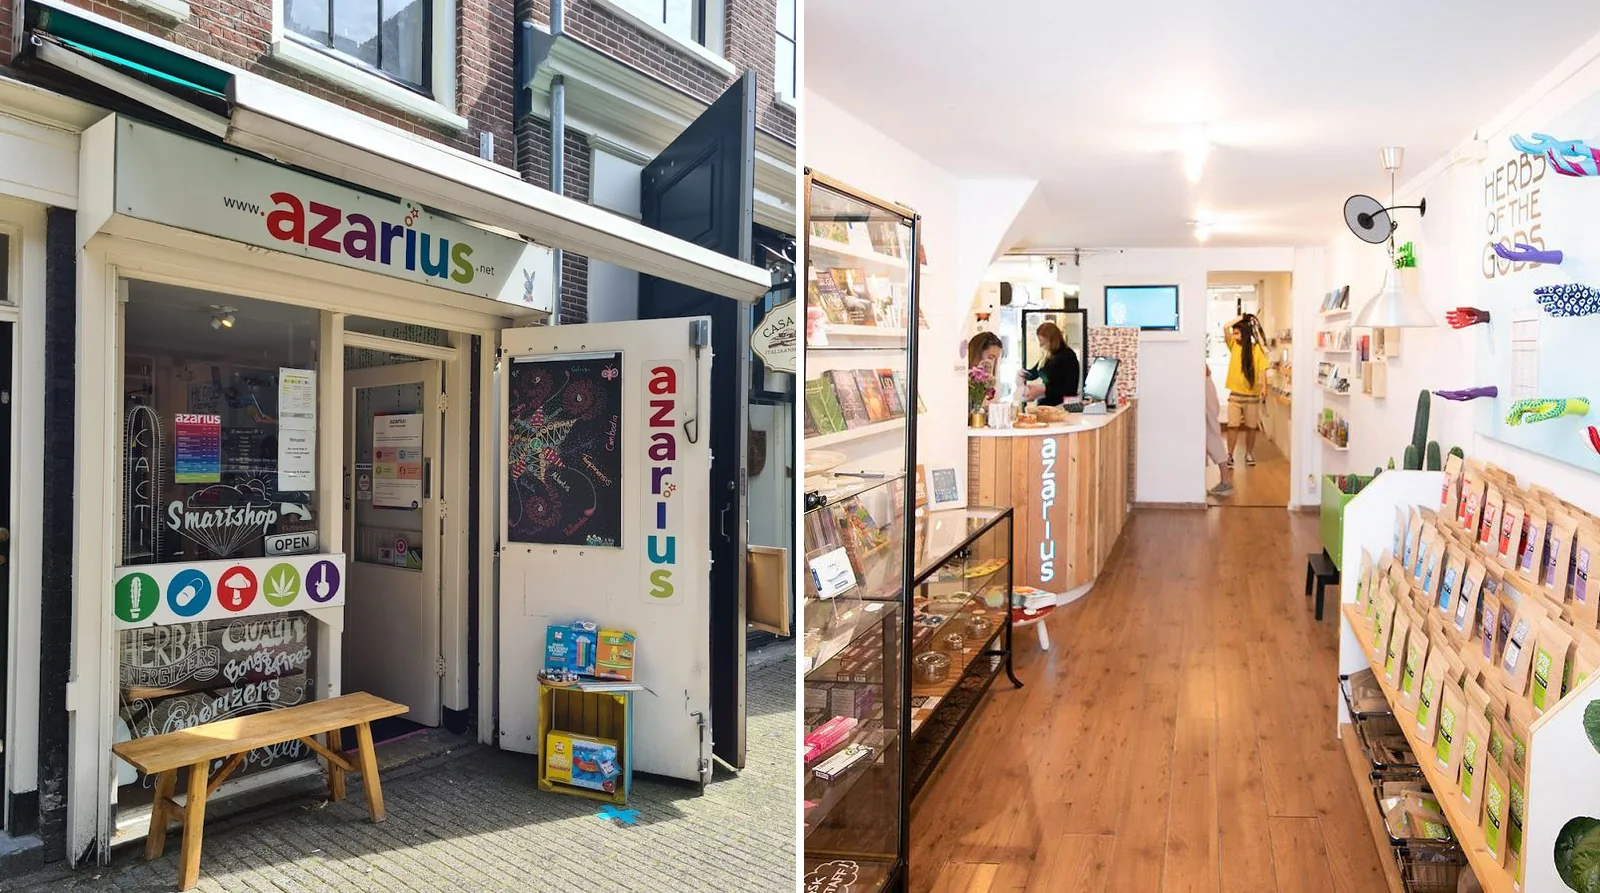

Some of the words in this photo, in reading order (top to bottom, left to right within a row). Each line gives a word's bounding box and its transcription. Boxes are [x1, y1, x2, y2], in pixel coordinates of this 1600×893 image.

[1485, 152, 1546, 208] HERBS
[1487, 205, 1506, 236] OF
[1508, 188, 1542, 227] THE
[1482, 223, 1545, 279] GODS
[762, 316, 795, 338] CASA
[175, 413, 221, 424] azarius
[605, 414, 619, 452] Cambodia
[134, 428, 150, 546] CACTI
[648, 366, 677, 599] azarius
[167, 500, 278, 535] Smartshop
[1040, 437, 1056, 582] azarius
[274, 536, 310, 552] OPEN
[119, 621, 209, 669] HERBAL
[222, 616, 312, 653] QUALITY
[120, 648, 218, 688] ENERGIZERS
